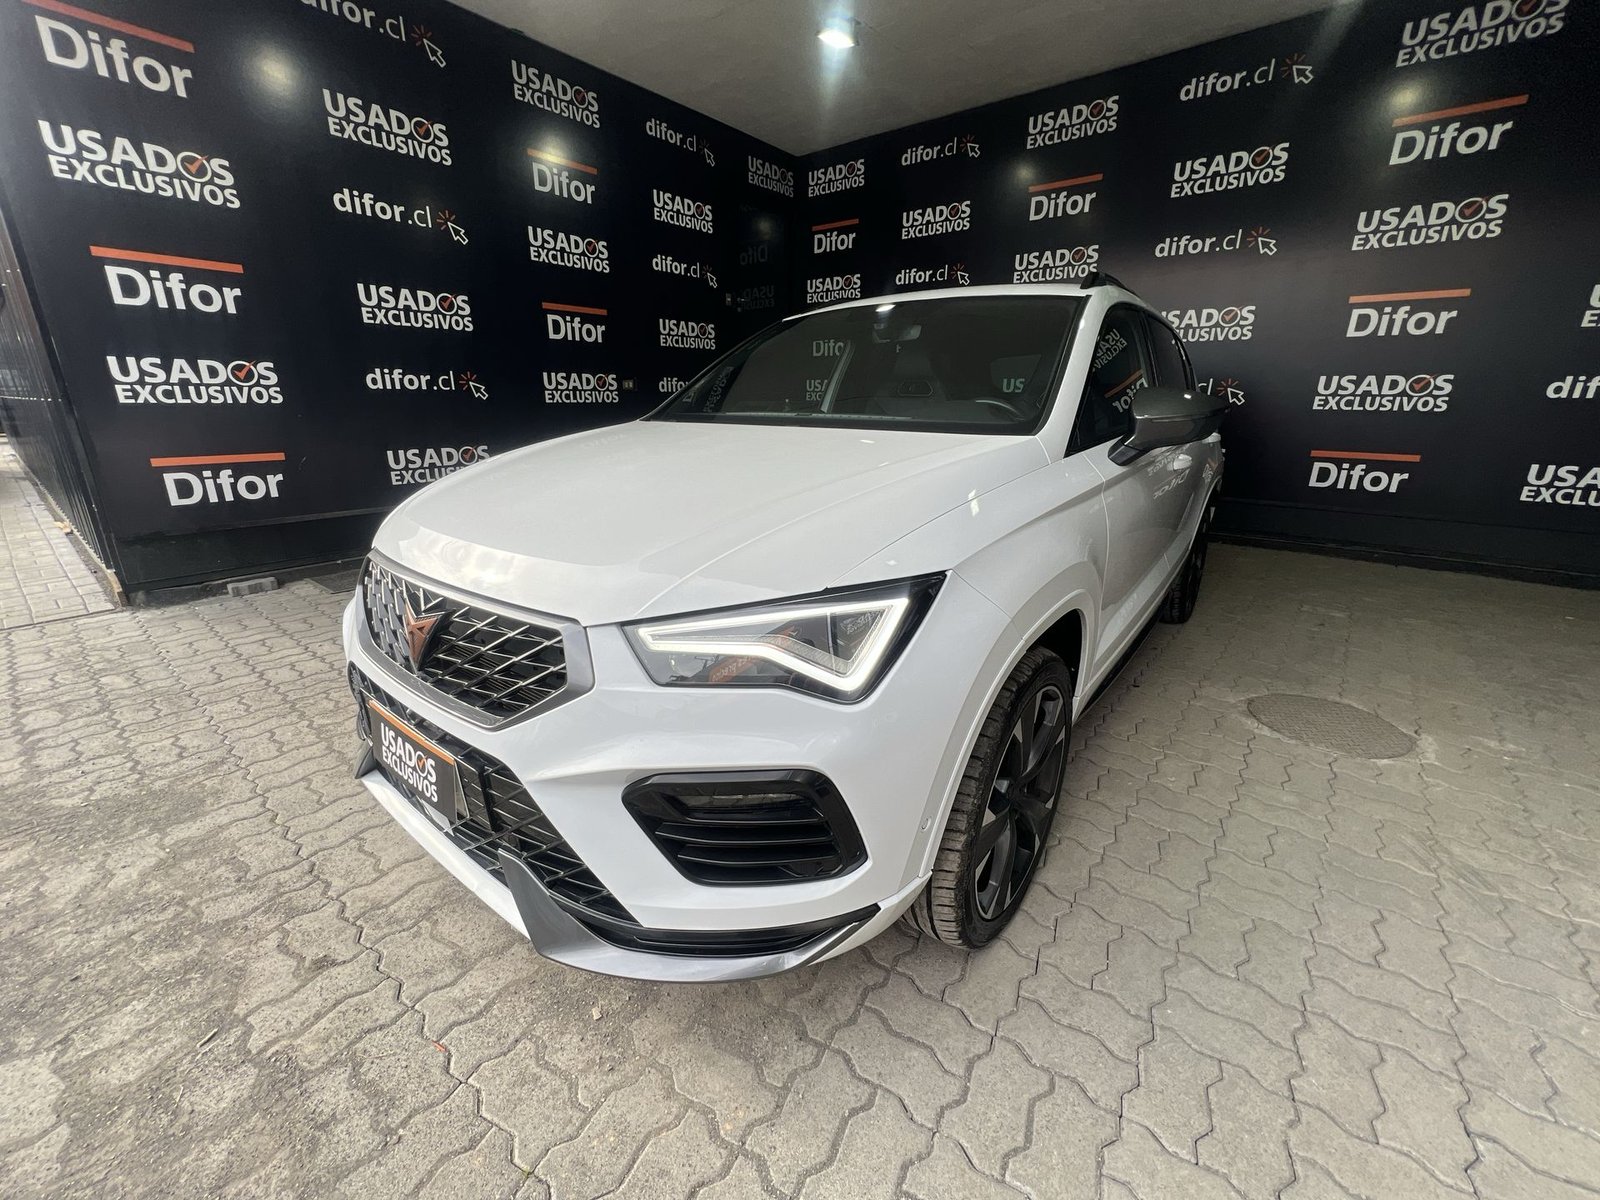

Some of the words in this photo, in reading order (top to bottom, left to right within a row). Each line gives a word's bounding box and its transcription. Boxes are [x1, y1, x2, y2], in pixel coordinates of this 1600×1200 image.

[302, 0, 406, 41] for.cl
[1396, 12, 1565, 67] EXCLUSIVOS
[35, 15, 192, 98] Difor
[511, 59, 599, 112] USADOS
[1179, 58, 1276, 102] difor.cl
[322, 88, 449, 147] USADOS
[514, 83, 600, 129] EXCLUSIVOS
[1028, 95, 1119, 134] USADOS
[327, 116, 452, 166] EXCLUSIVOS
[646, 118, 697, 151] difor.cl
[1026, 115, 1118, 150] EXCLUSIVOS
[1389, 121, 1513, 165] Difor
[37, 119, 235, 187] USADOS
[901, 136, 957, 166] difor.cl
[1173, 141, 1290, 183] USADOS
[48, 154, 240, 209] EXCLUSIVOS
[532, 162, 596, 204] Difor
[748, 155, 794, 186] USADOS
[748, 172, 794, 198] EXCLUSIVOS
[808, 158, 865, 186] USADOS
[1170, 165, 1286, 199] EXCLUSIVOS
[808, 174, 865, 198] EXCLUSIVOS
[332, 188, 433, 229] difor.cl
[653, 189, 713, 221] USADOS
[902, 200, 971, 228] USADOS
[1029, 191, 1097, 222] Difor
[1356, 193, 1509, 234] USADOS
[654, 207, 713, 234] EXCLUSIVOS
[901, 217, 970, 240] EXCLUSIVOS
[1351, 219, 1503, 251] EXCLUSIVOS
[528, 226, 608, 259] USADOS
[813, 231, 856, 254] Difor
[1014, 244, 1100, 271] USADOS
[1154, 228, 1243, 258] difor.cl
[530, 247, 610, 273] EXCLUSIVOS
[652, 254, 700, 278] difor.cl
[895, 264, 948, 286] difor.cl
[1013, 263, 1098, 284] EXCLUSIVOS
[104, 265, 242, 314] Difor
[807, 273, 861, 293] USADOS
[807, 288, 861, 304] EXCLUSIVOS
[357, 283, 471, 316] USADOS
[361, 307, 474, 332] EXCLUSIVOS
[546, 314, 606, 343] Difor
[659, 319, 715, 338] USADOS
[1174, 326, 1253, 343] LUSIVOS
[1346, 306, 1458, 338] Difor
[660, 334, 716, 350] EXCLUSIVOS
[813, 340, 844, 357] Difo
[106, 355, 279, 387] USADOS
[365, 368, 456, 391] difor.cl
[543, 371, 617, 391] USADOS
[659, 377, 688, 392] difo
[1316, 374, 1454, 396] USADOS
[114, 384, 284, 404] EXCLUSIVOS
[545, 390, 619, 403] EXCLUSIVOS
[1312, 396, 1449, 412] EXCLUSIVOS
[386, 445, 490, 470] USADOS
[163, 469, 284, 507] Difor
[1308, 461, 1408, 494] Difor
[1527, 463, 1600, 488] USA
[1520, 486, 1600, 507] EXCLU
[381, 722, 437, 783] USADOS
[381, 746, 438, 803] EXCLUSIVOS
